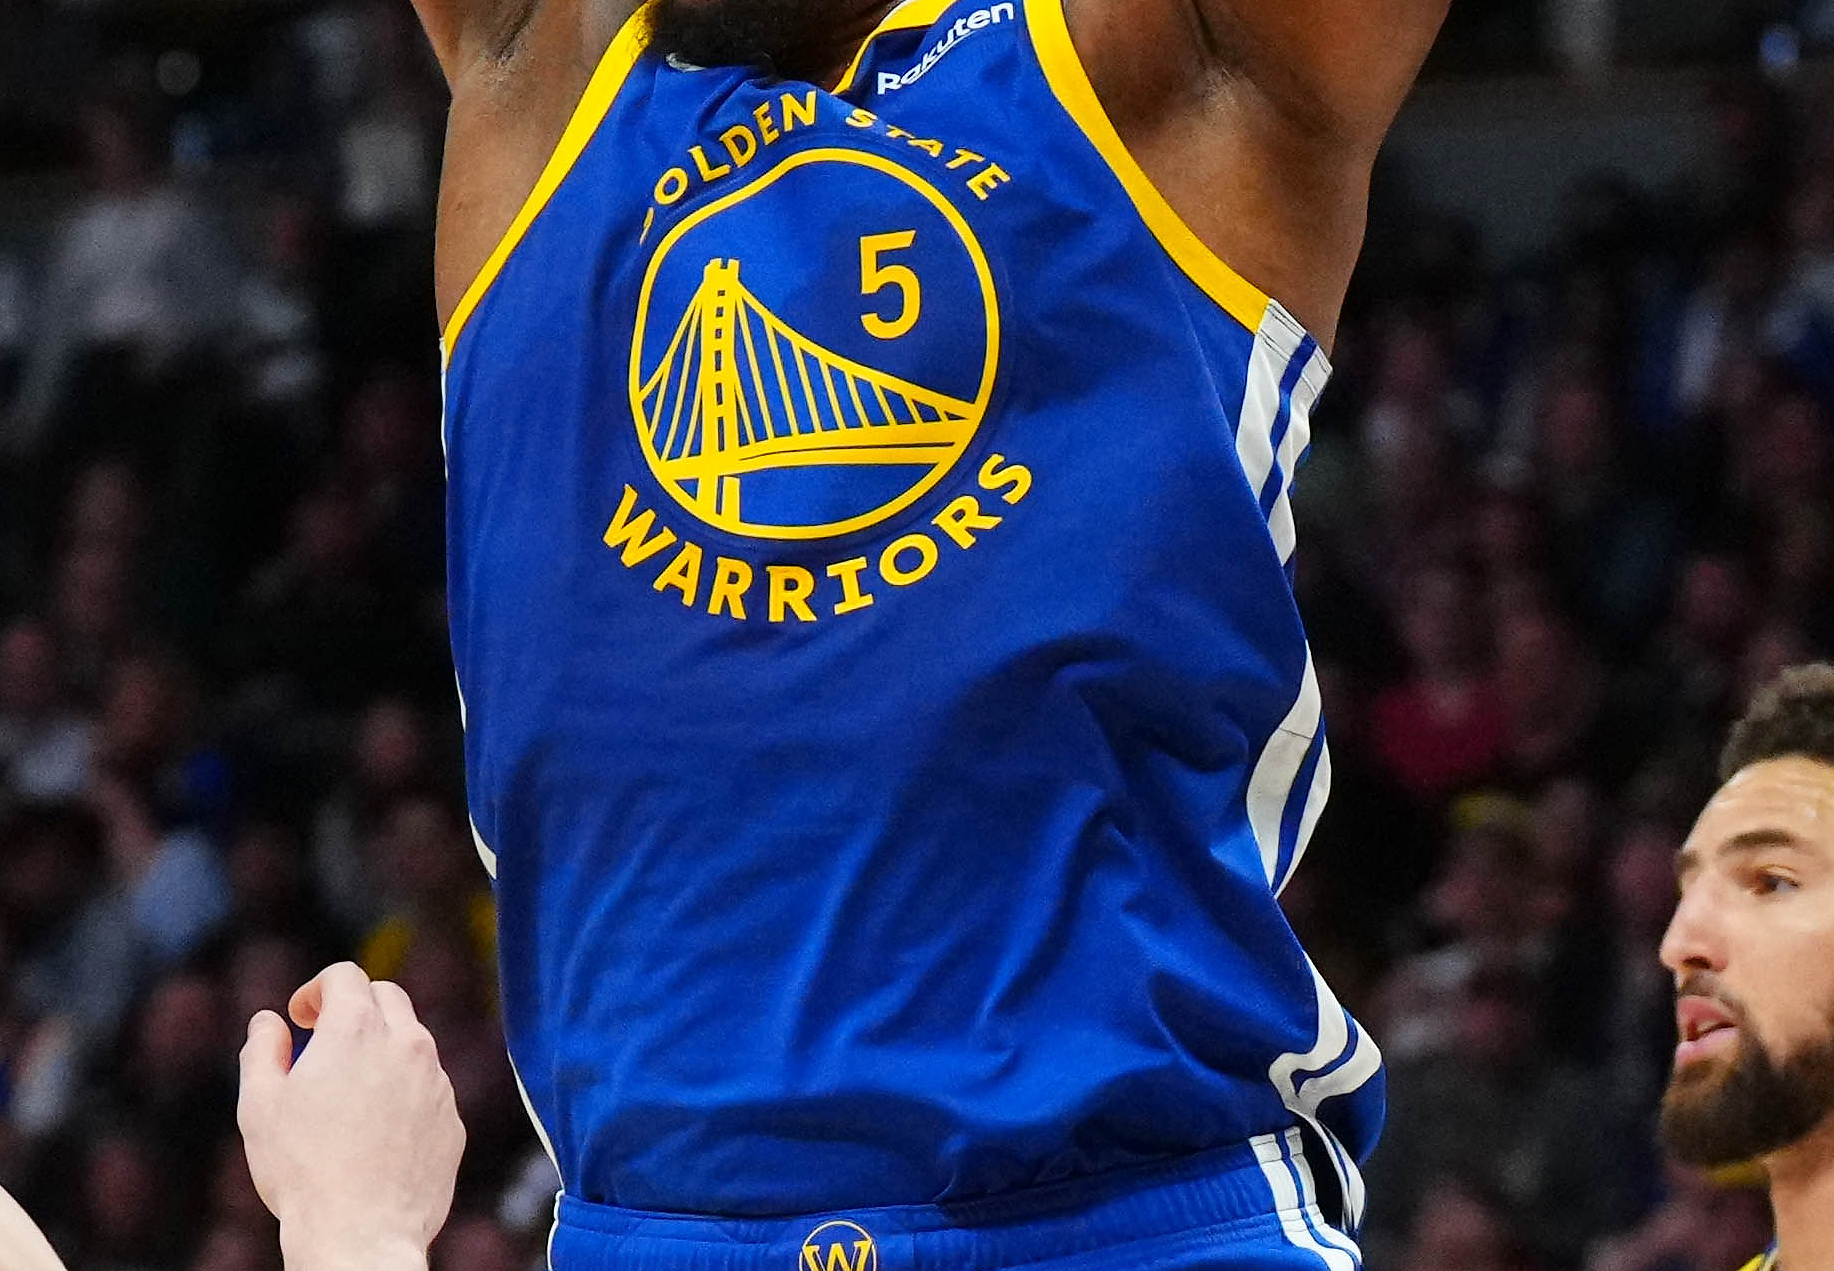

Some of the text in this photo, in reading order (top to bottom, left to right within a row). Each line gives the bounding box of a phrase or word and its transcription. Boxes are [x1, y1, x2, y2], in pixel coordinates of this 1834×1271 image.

[877, 1, 1015, 96] Rakuten
[640, 90, 1012, 244] OLDEN STATE
[859, 229, 921, 340] 5
[602, 452, 1033, 624] WARRIORS
